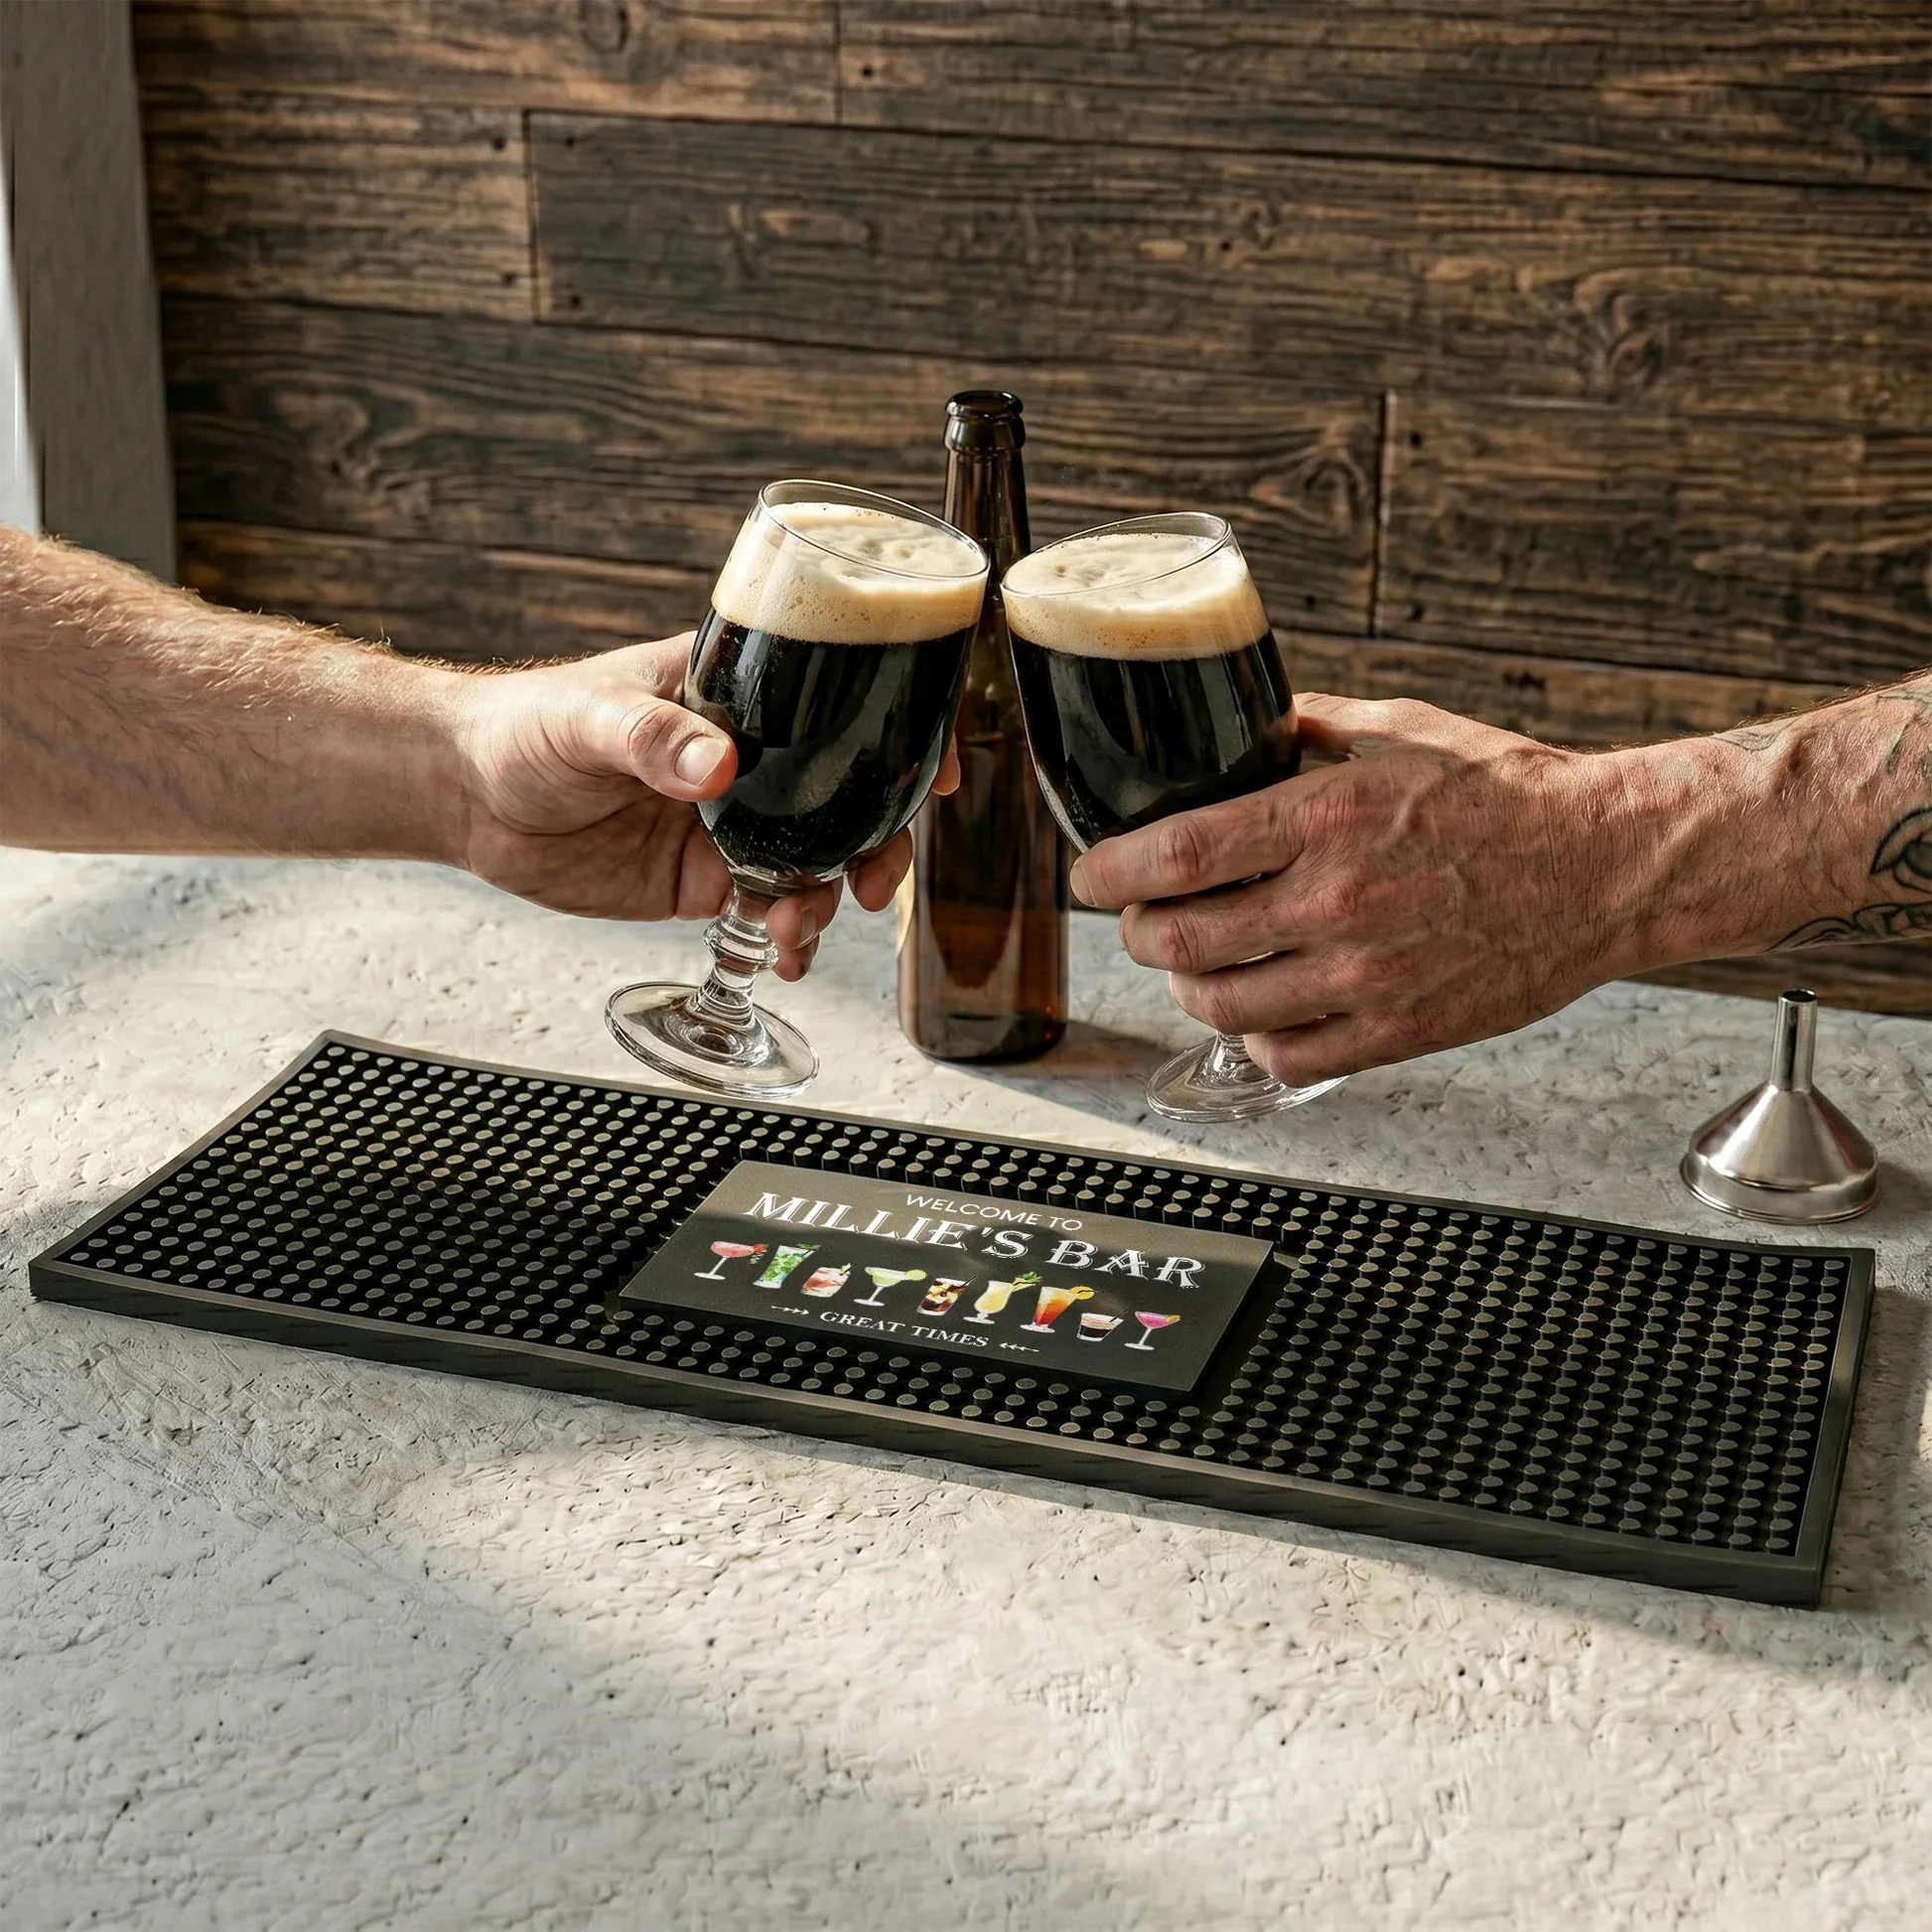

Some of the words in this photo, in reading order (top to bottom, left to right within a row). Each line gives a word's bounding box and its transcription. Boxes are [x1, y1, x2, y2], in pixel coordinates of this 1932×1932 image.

[905, 1194, 1041, 1226] WELCOME
[1048, 1215, 1083, 1231] TO
[743, 1191, 1034, 1258] MILLIE'S
[1044, 1239, 1205, 1289] BAR
[819, 1311, 905, 1333] GREAT
[910, 1326, 989, 1347] TIMES
